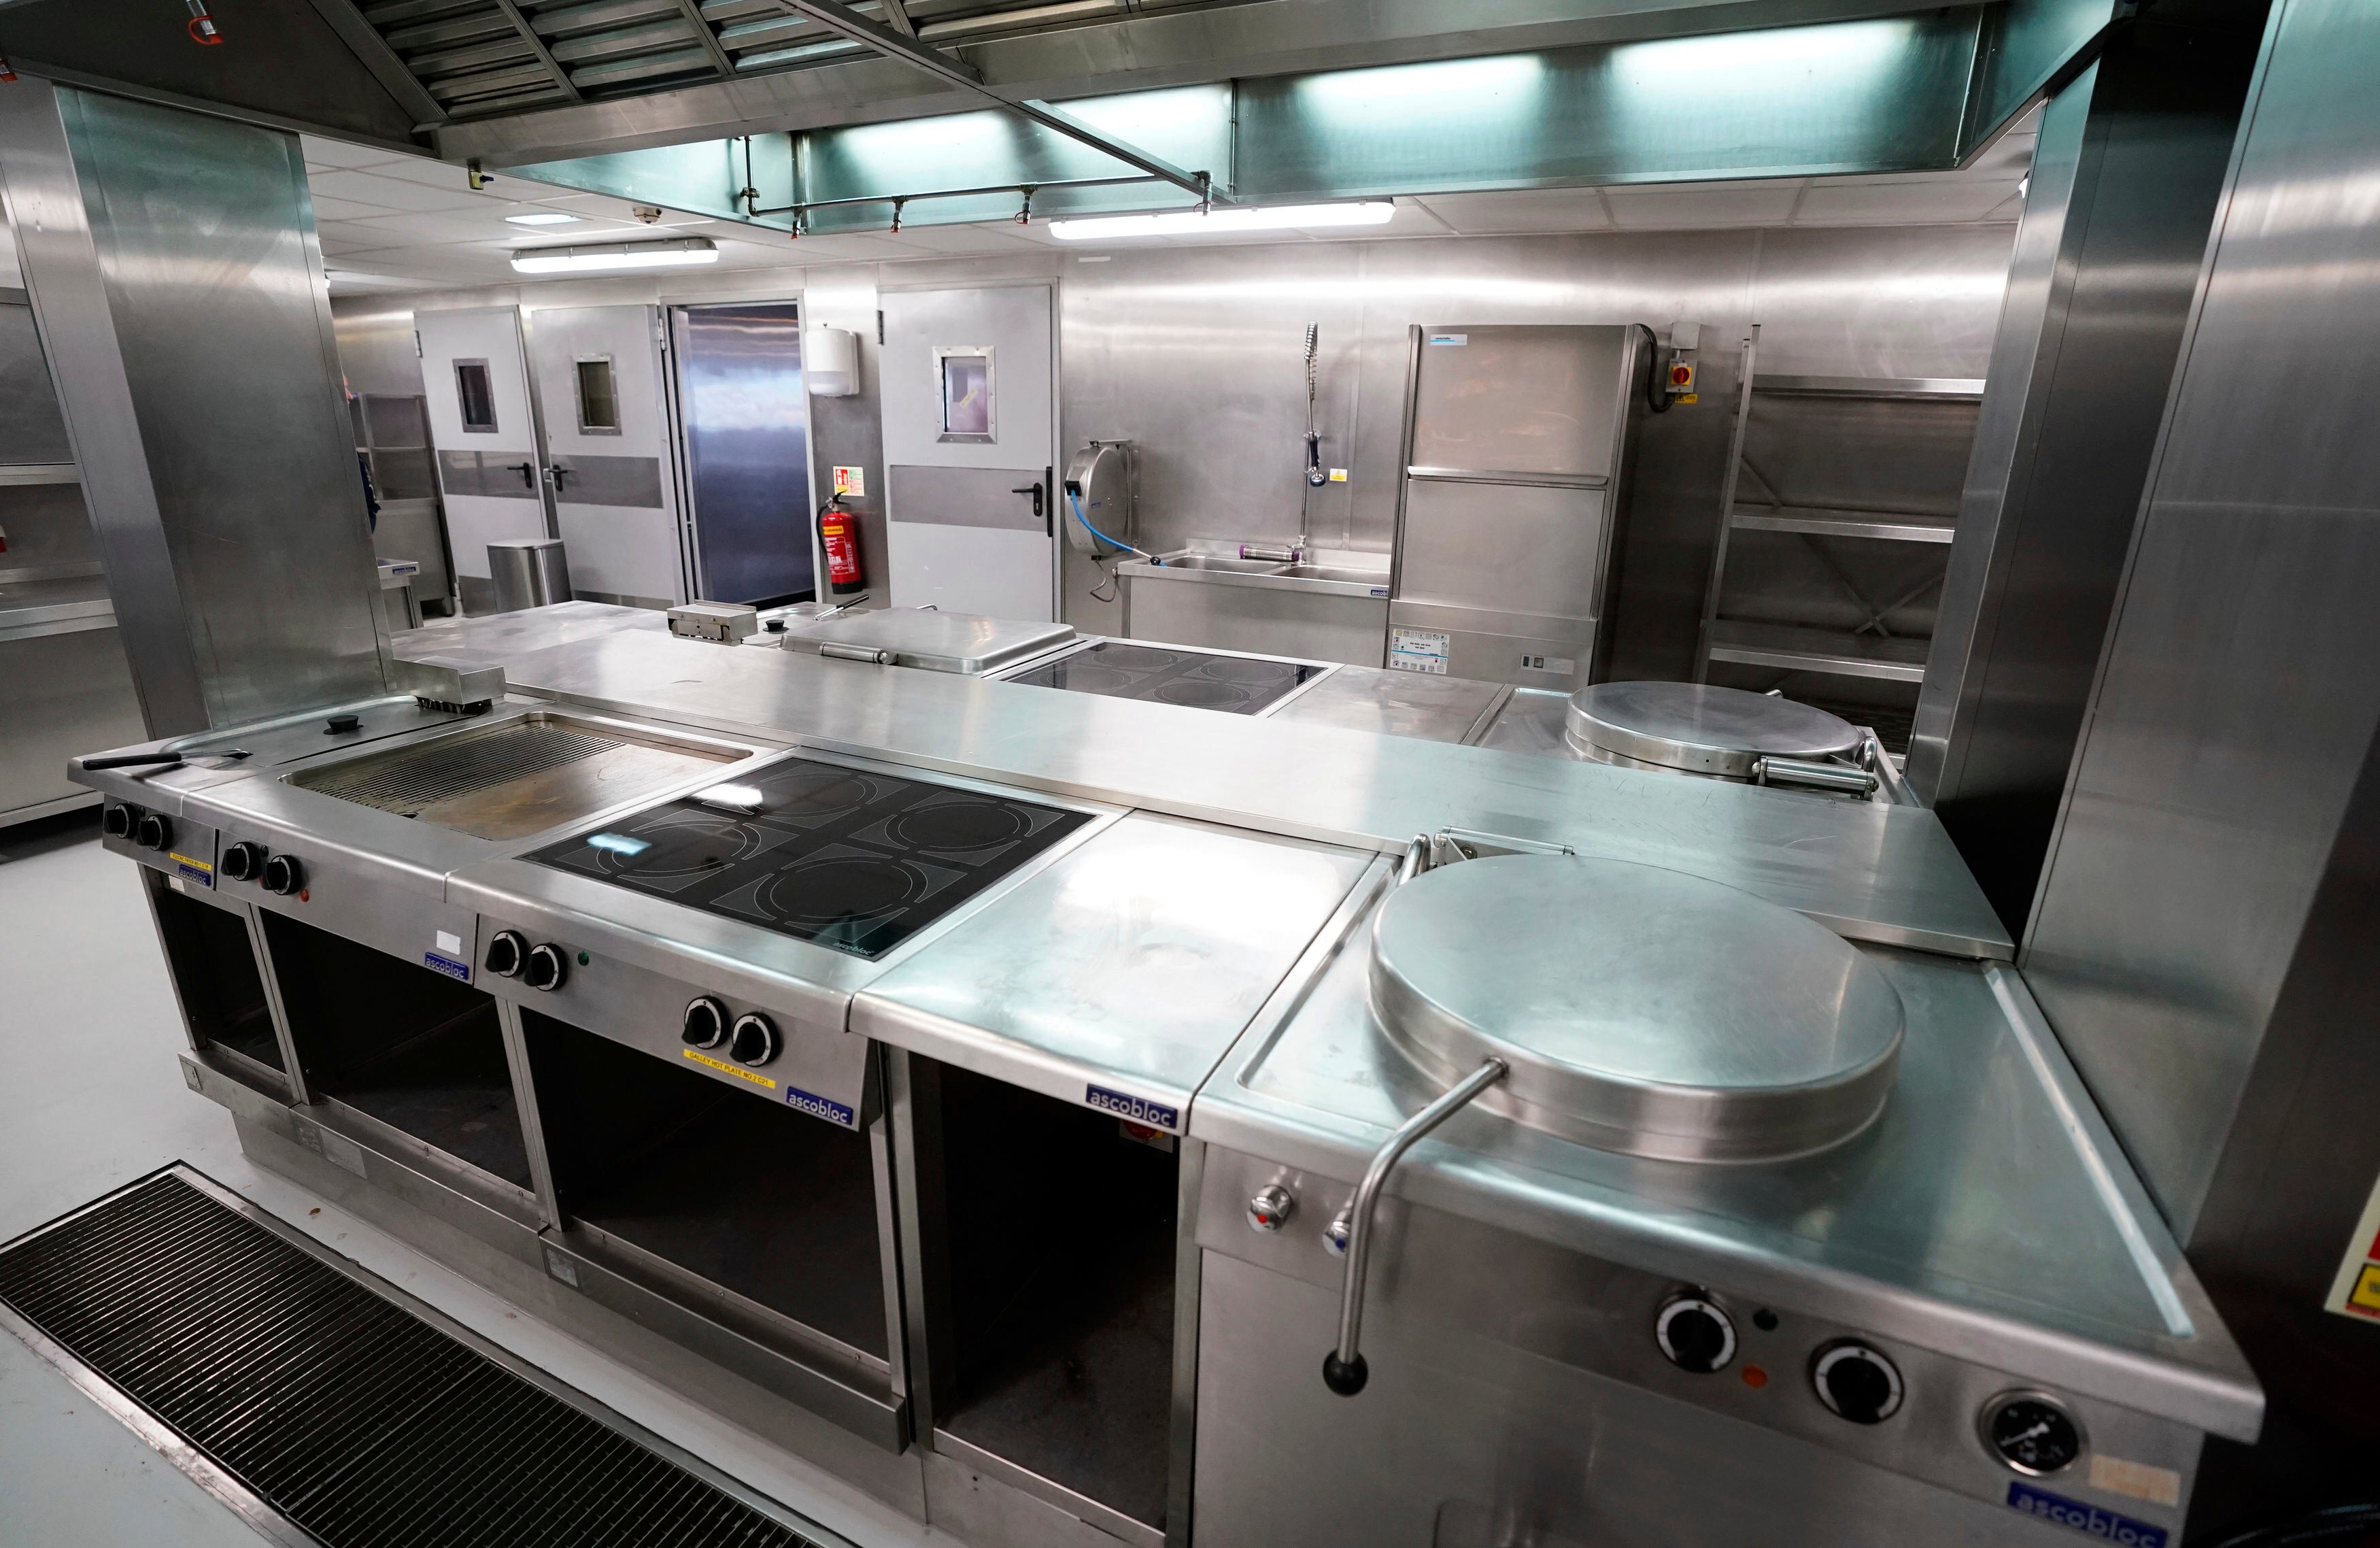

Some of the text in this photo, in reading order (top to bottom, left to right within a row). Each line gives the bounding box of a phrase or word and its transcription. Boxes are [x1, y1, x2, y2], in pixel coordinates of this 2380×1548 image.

[180, 869, 206, 885] ascobloc
[426, 957, 464, 979] ascobloc
[690, 1051, 711, 1066] GALLEY
[711, 1060, 723, 1070] HOT
[724, 1064, 741, 1077] PLATE
[758, 1076, 768, 1086] C21
[789, 1093, 848, 1123] ascobloc
[1090, 1092, 1171, 1127] ascobloc
[2016, 1492, 2158, 1548] ascobloc
